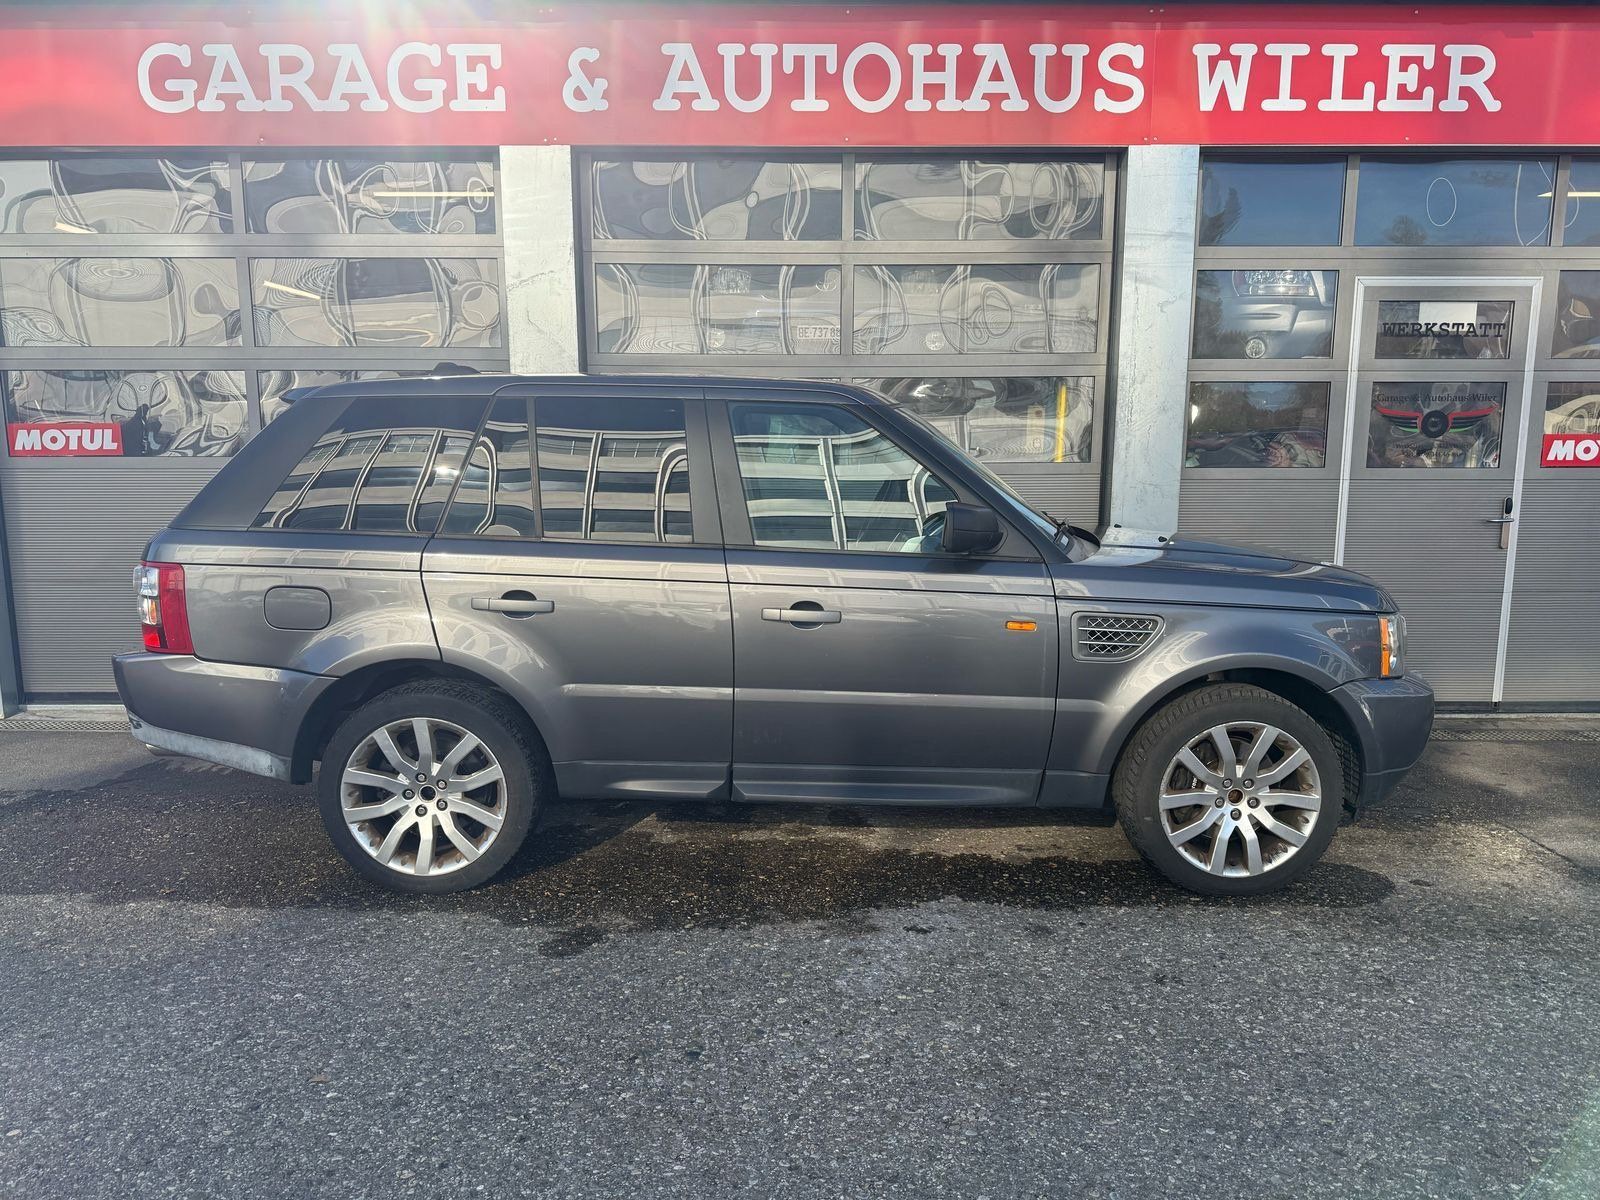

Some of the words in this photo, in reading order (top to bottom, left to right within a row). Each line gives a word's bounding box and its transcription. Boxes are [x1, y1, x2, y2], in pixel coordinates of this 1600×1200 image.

[137, 42, 507, 114] GARAGE
[563, 47, 609, 113] &
[653, 42, 1145, 114] AUTOHAUS
[1192, 43, 1502, 113] WILER
[1382, 322, 1506, 338] WERKSTATT
[1424, 392, 1469, 403] Autohaus
[14, 428, 118, 451] MOTUL
[1546, 439, 1600, 461] MO
